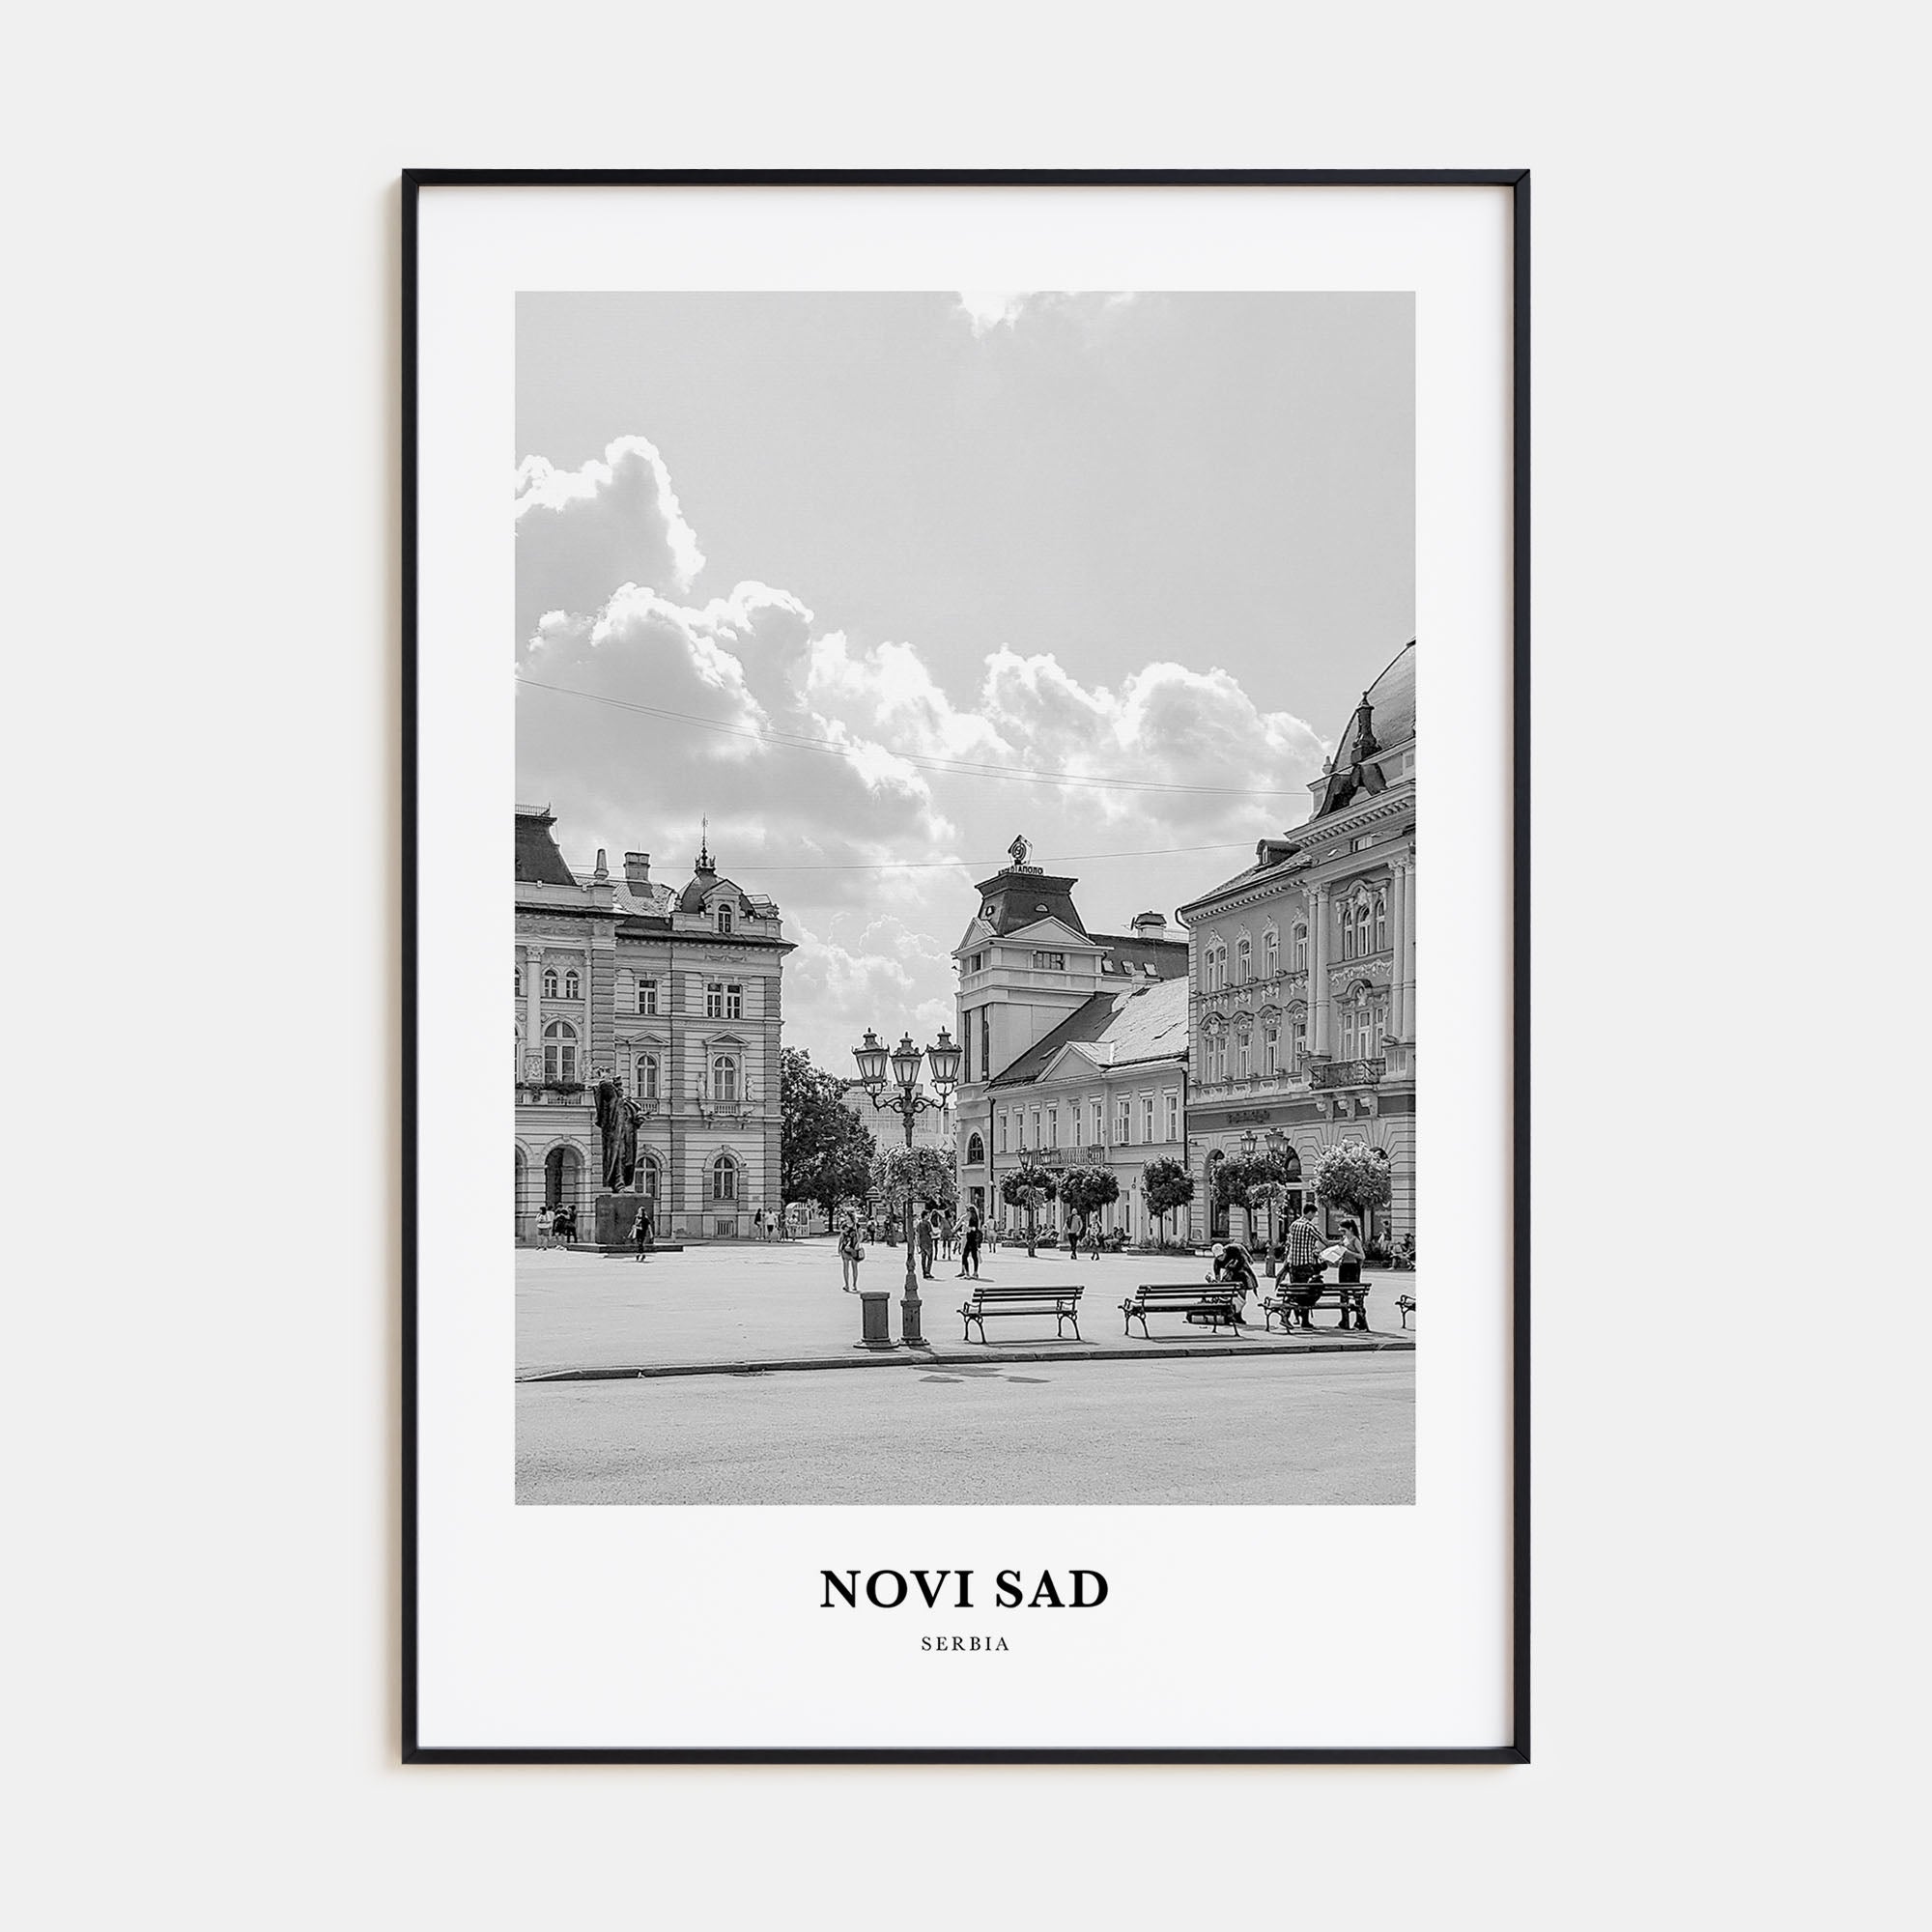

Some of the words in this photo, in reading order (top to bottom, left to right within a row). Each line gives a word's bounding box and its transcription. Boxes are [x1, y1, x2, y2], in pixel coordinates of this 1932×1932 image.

[820, 1570, 974, 1607] NOVI
[996, 1570, 1108, 1607] SAD
[922, 1636, 1009, 1651] SERBIA
